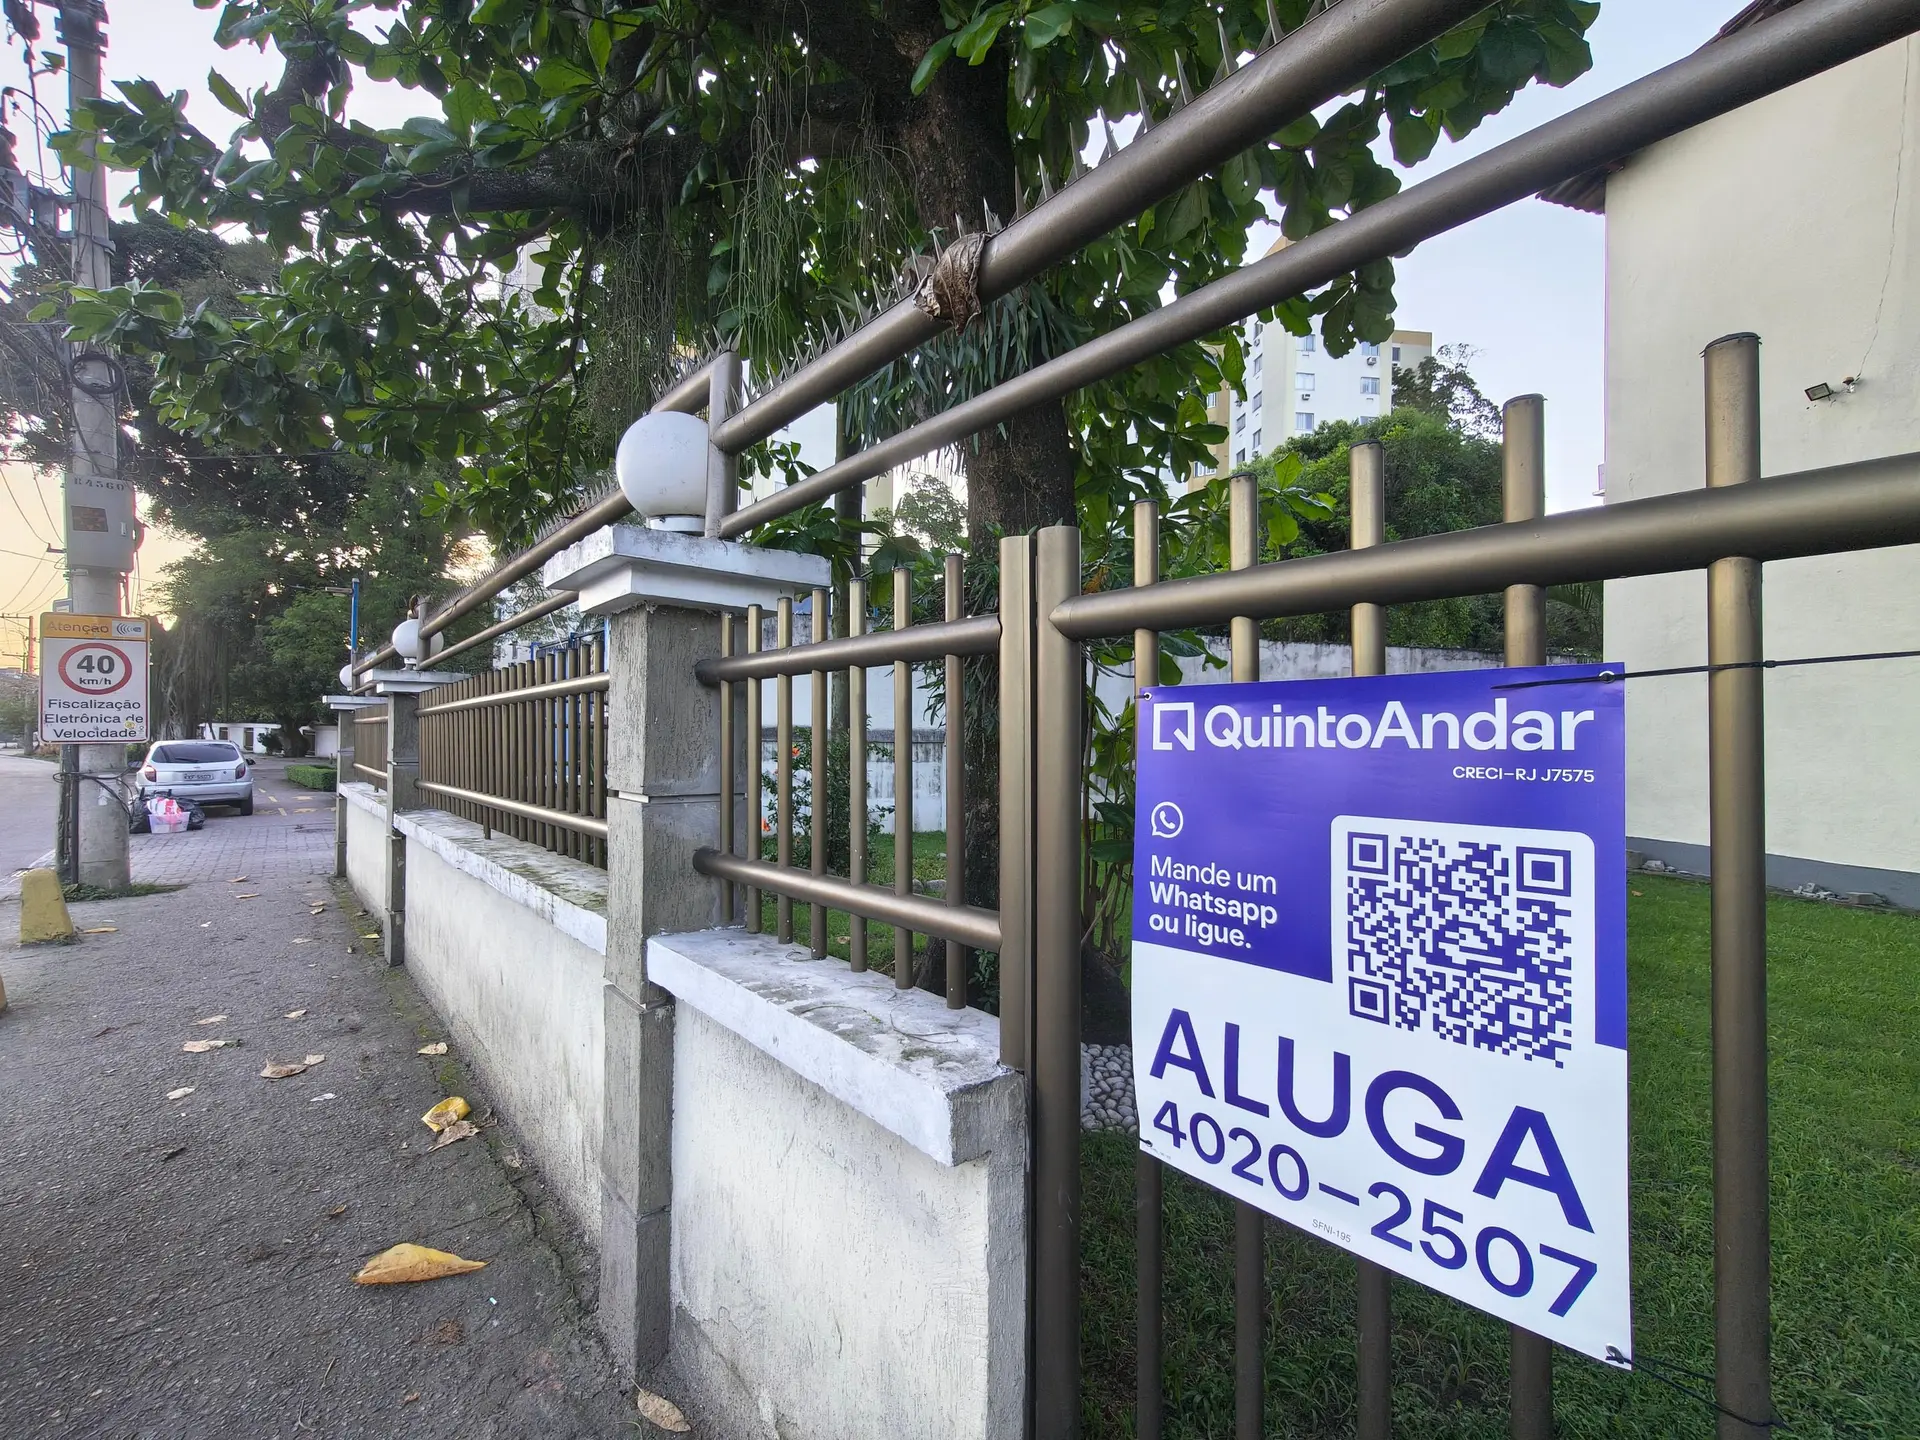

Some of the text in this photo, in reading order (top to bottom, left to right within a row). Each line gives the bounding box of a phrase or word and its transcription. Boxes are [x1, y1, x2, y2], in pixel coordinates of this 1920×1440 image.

[76, 654, 115, 674] 40
[79, 677, 112, 685] km/h
[48, 698, 141, 711] Fiscalização
[44, 713, 144, 724] Eletrônica de
[1204, 697, 1594, 751] QuintoAndar
[53, 728, 137, 738] Velocidade
[1541, 767, 1595, 783] J7575
[1151, 854, 1277, 895] Mande um
[1149, 881, 1278, 929] Whatsapp
[1149, 912, 1252, 949] ou ligue.
[1149, 1008, 1595, 1234] ALUGA
[1312, 1218, 1351, 1243] SFNI-195
